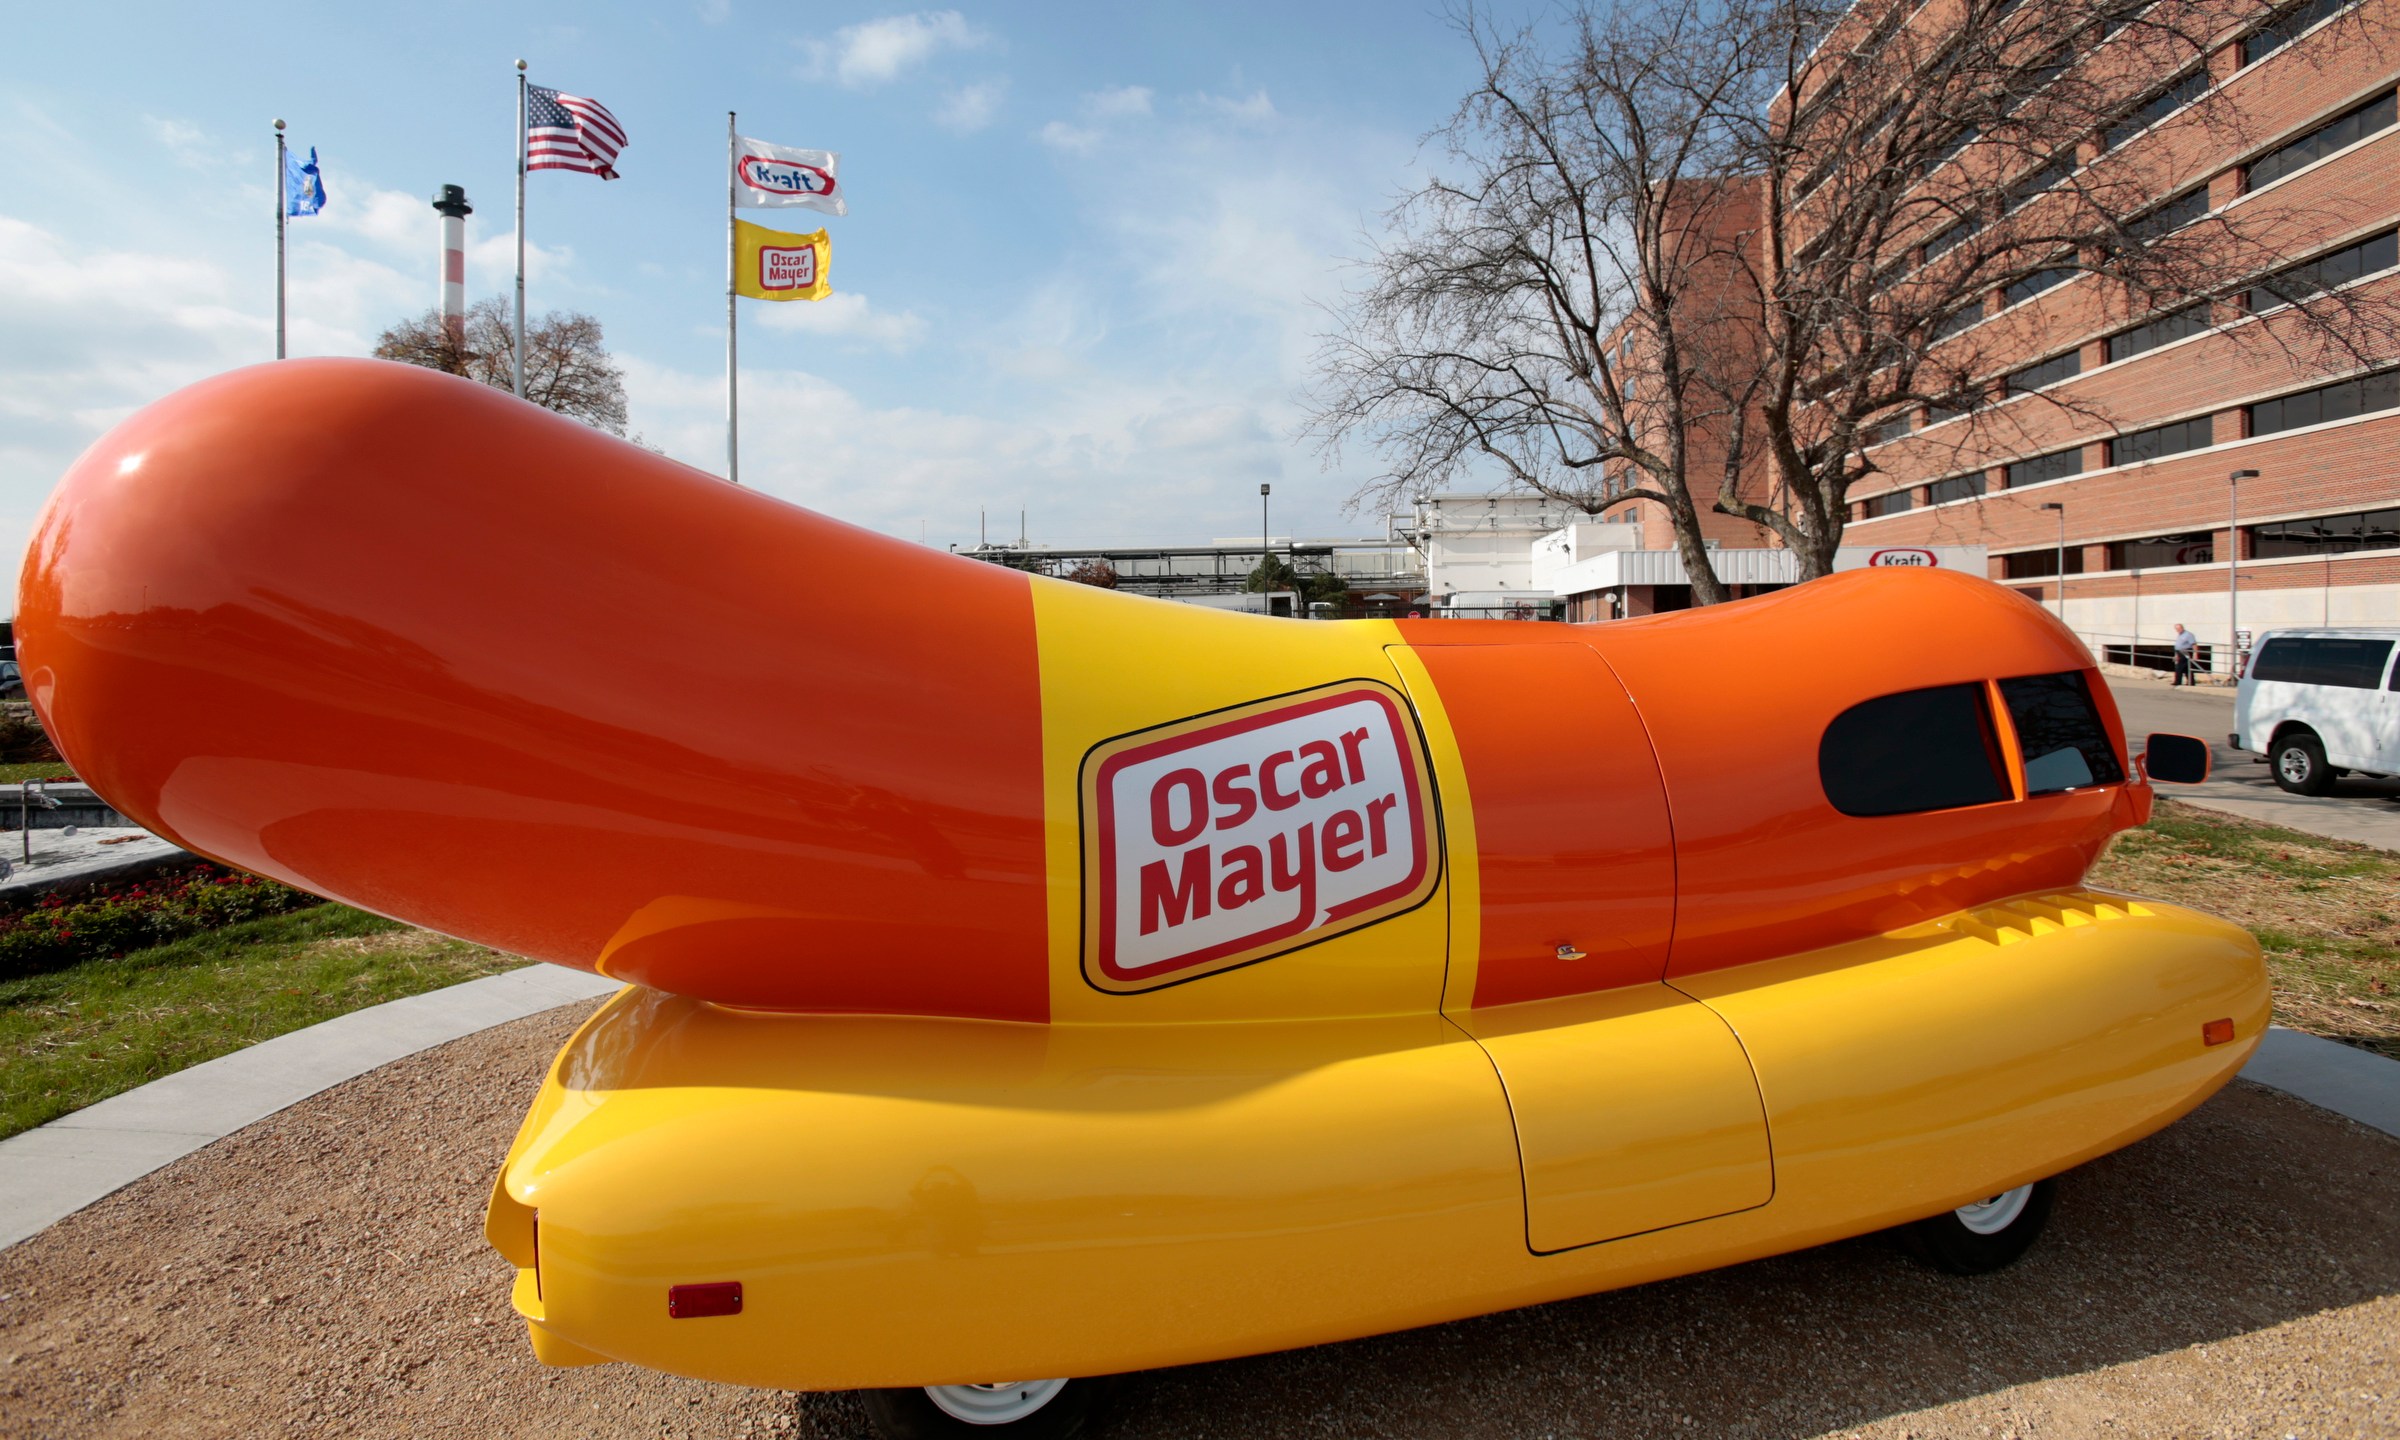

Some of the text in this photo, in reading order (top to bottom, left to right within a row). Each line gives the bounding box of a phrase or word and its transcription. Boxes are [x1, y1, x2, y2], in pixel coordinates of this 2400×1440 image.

[756, 165, 814, 191] Kraft
[771, 253, 807, 266] Oscar
[769, 266, 810, 284] Mayer
[1884, 554, 1922, 566] Kraft
[1150, 727, 1370, 848] Oscar
[1139, 792, 1397, 936] Mayer
